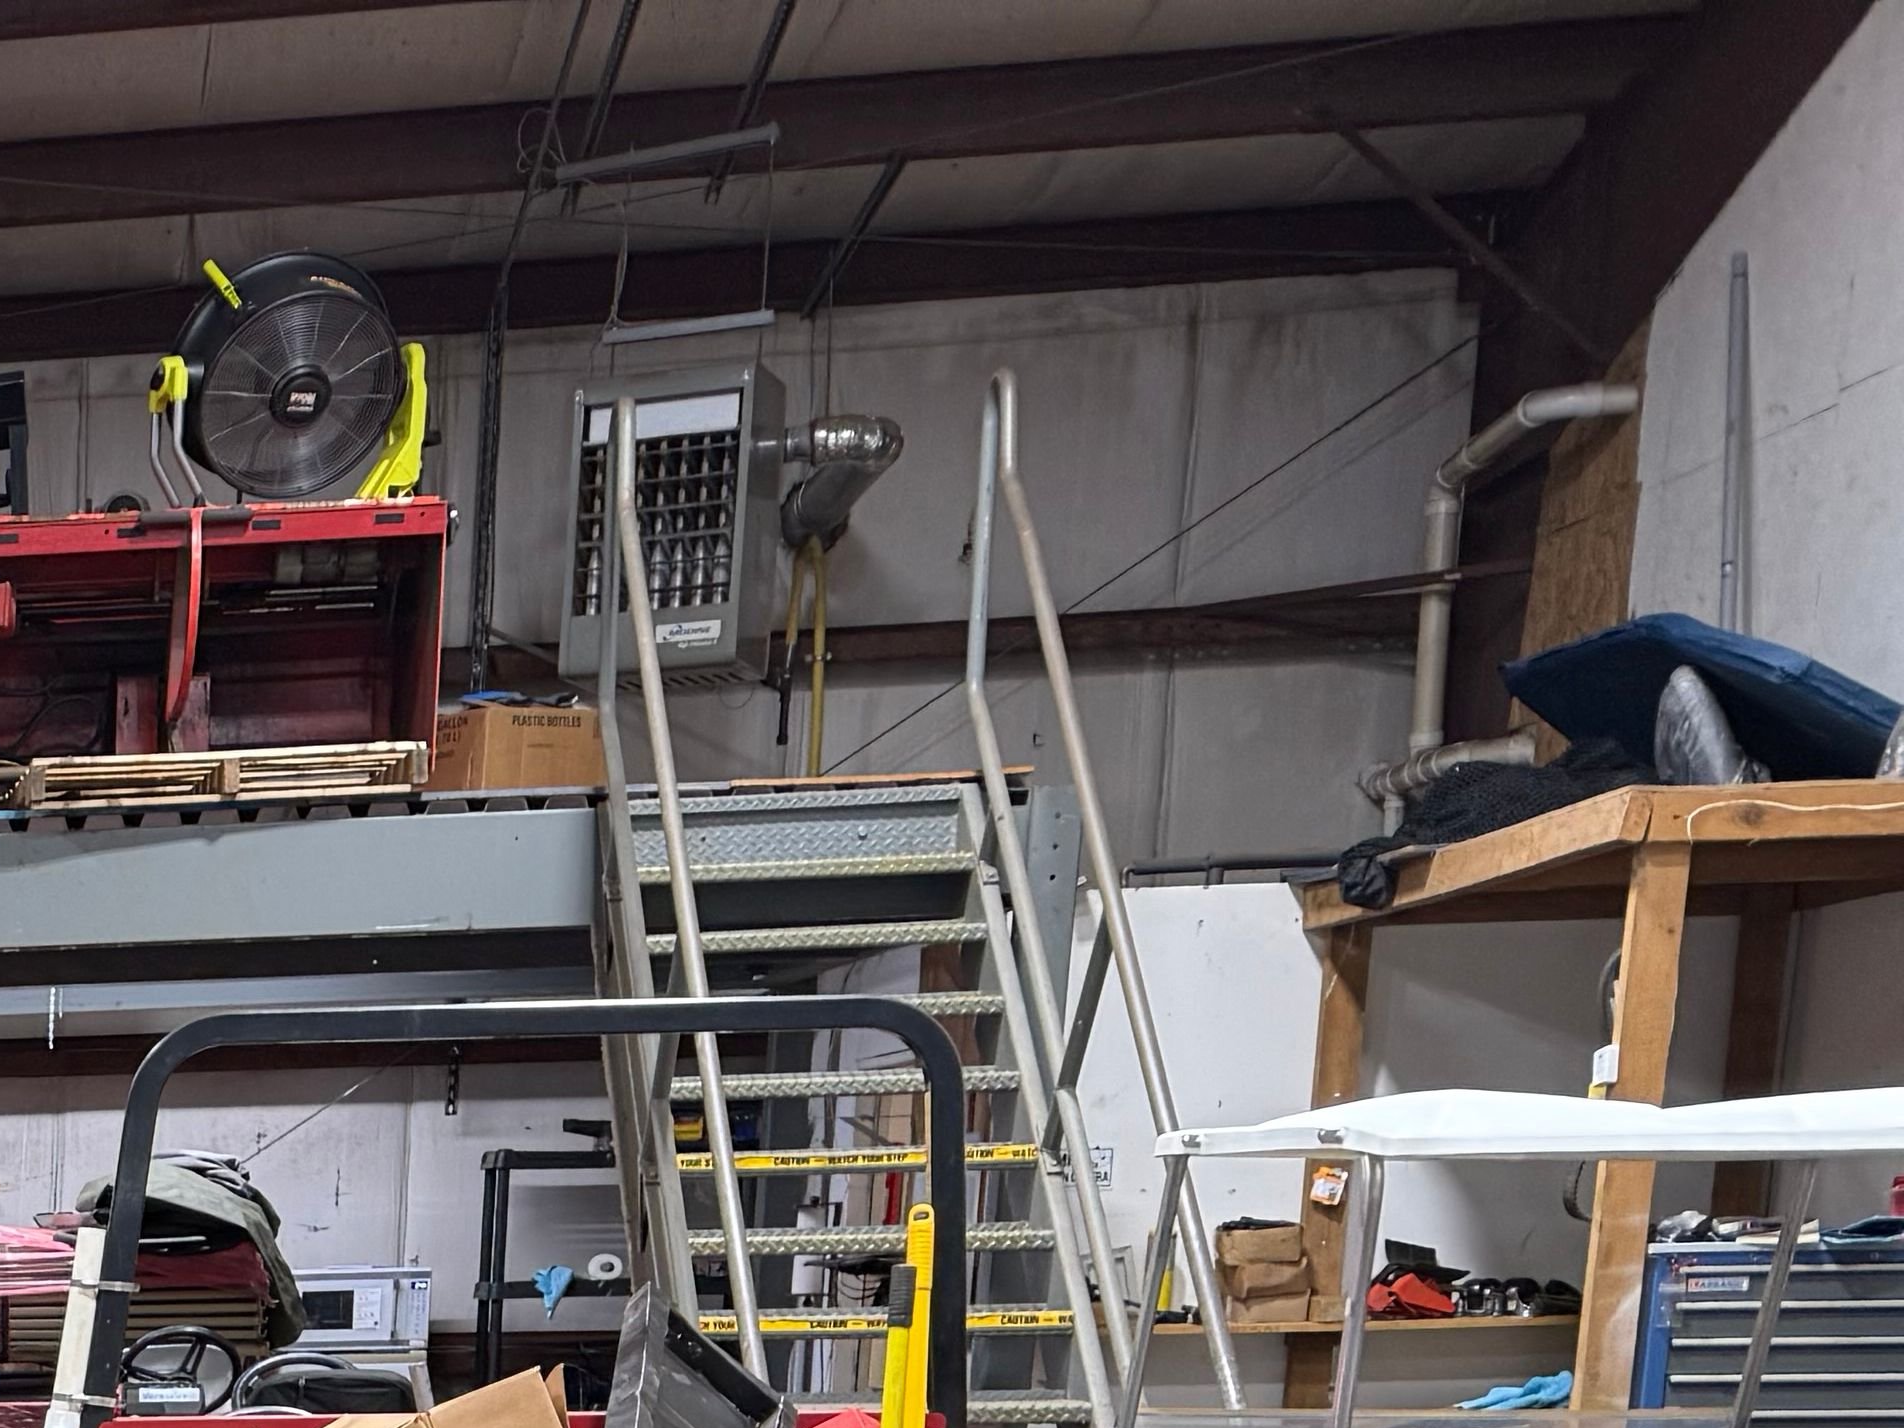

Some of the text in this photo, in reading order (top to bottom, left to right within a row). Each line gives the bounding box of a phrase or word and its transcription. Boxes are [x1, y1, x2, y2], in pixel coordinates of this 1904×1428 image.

[512, 715, 581, 728] PLASTIC BOTTLES
[1001, 1315, 1039, 1324] CAUTION
